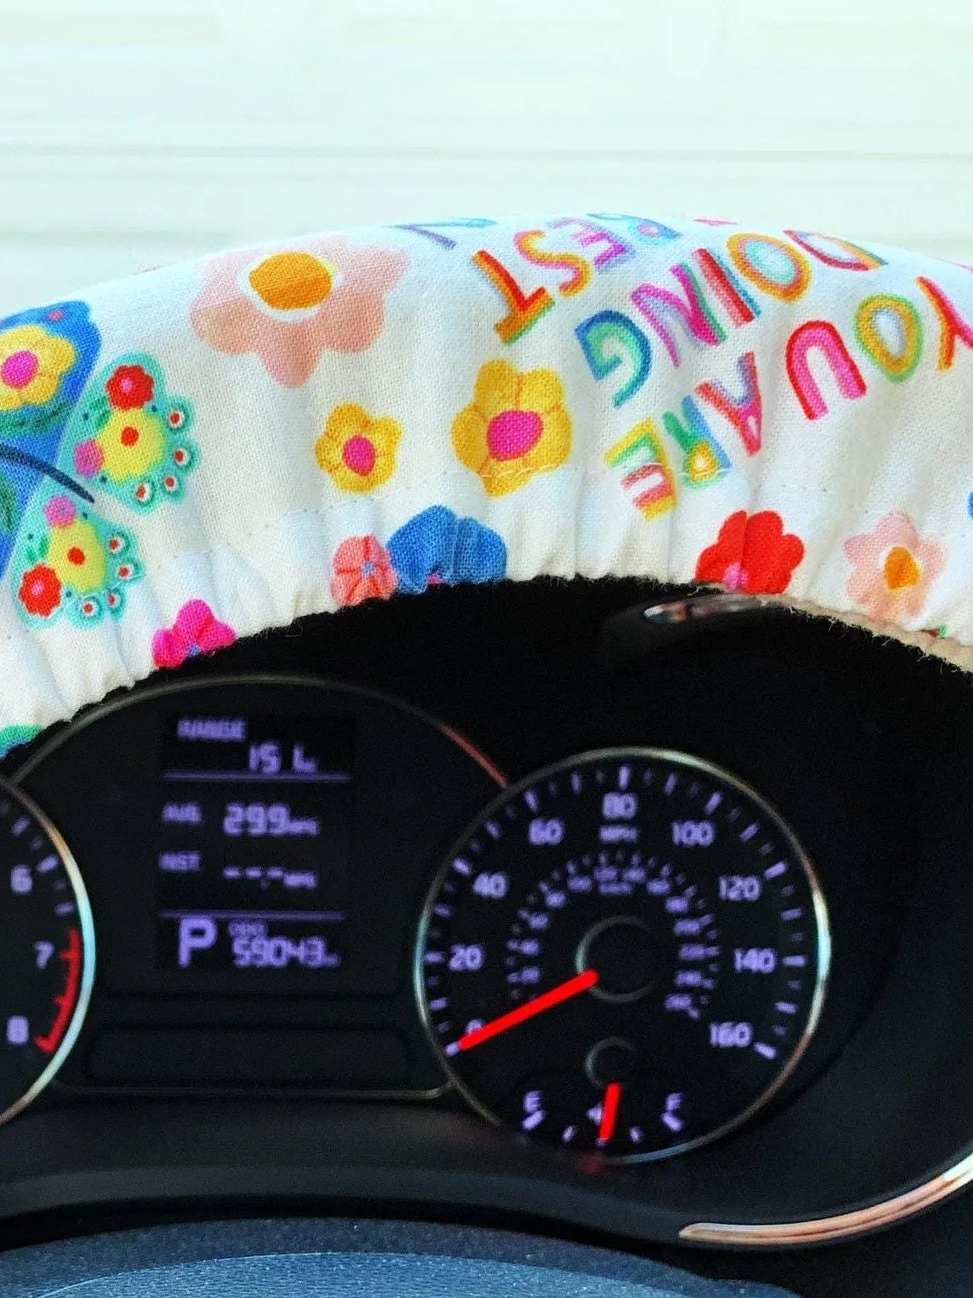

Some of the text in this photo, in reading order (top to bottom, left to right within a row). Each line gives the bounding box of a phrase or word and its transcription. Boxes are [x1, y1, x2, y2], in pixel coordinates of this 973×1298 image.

[575, 228, 889, 408] DOING
[604, 274, 973, 521] YOU ARE
[672, 819, 715, 848] 100
[472, 871, 507, 899] 40
[719, 875, 762, 901] 120
[33, 941, 54, 969] 7
[179, 916, 217, 967] P
[448, 943, 483, 972] 20
[733, 947, 777, 974] 140
[710, 1021, 753, 1049] 160
